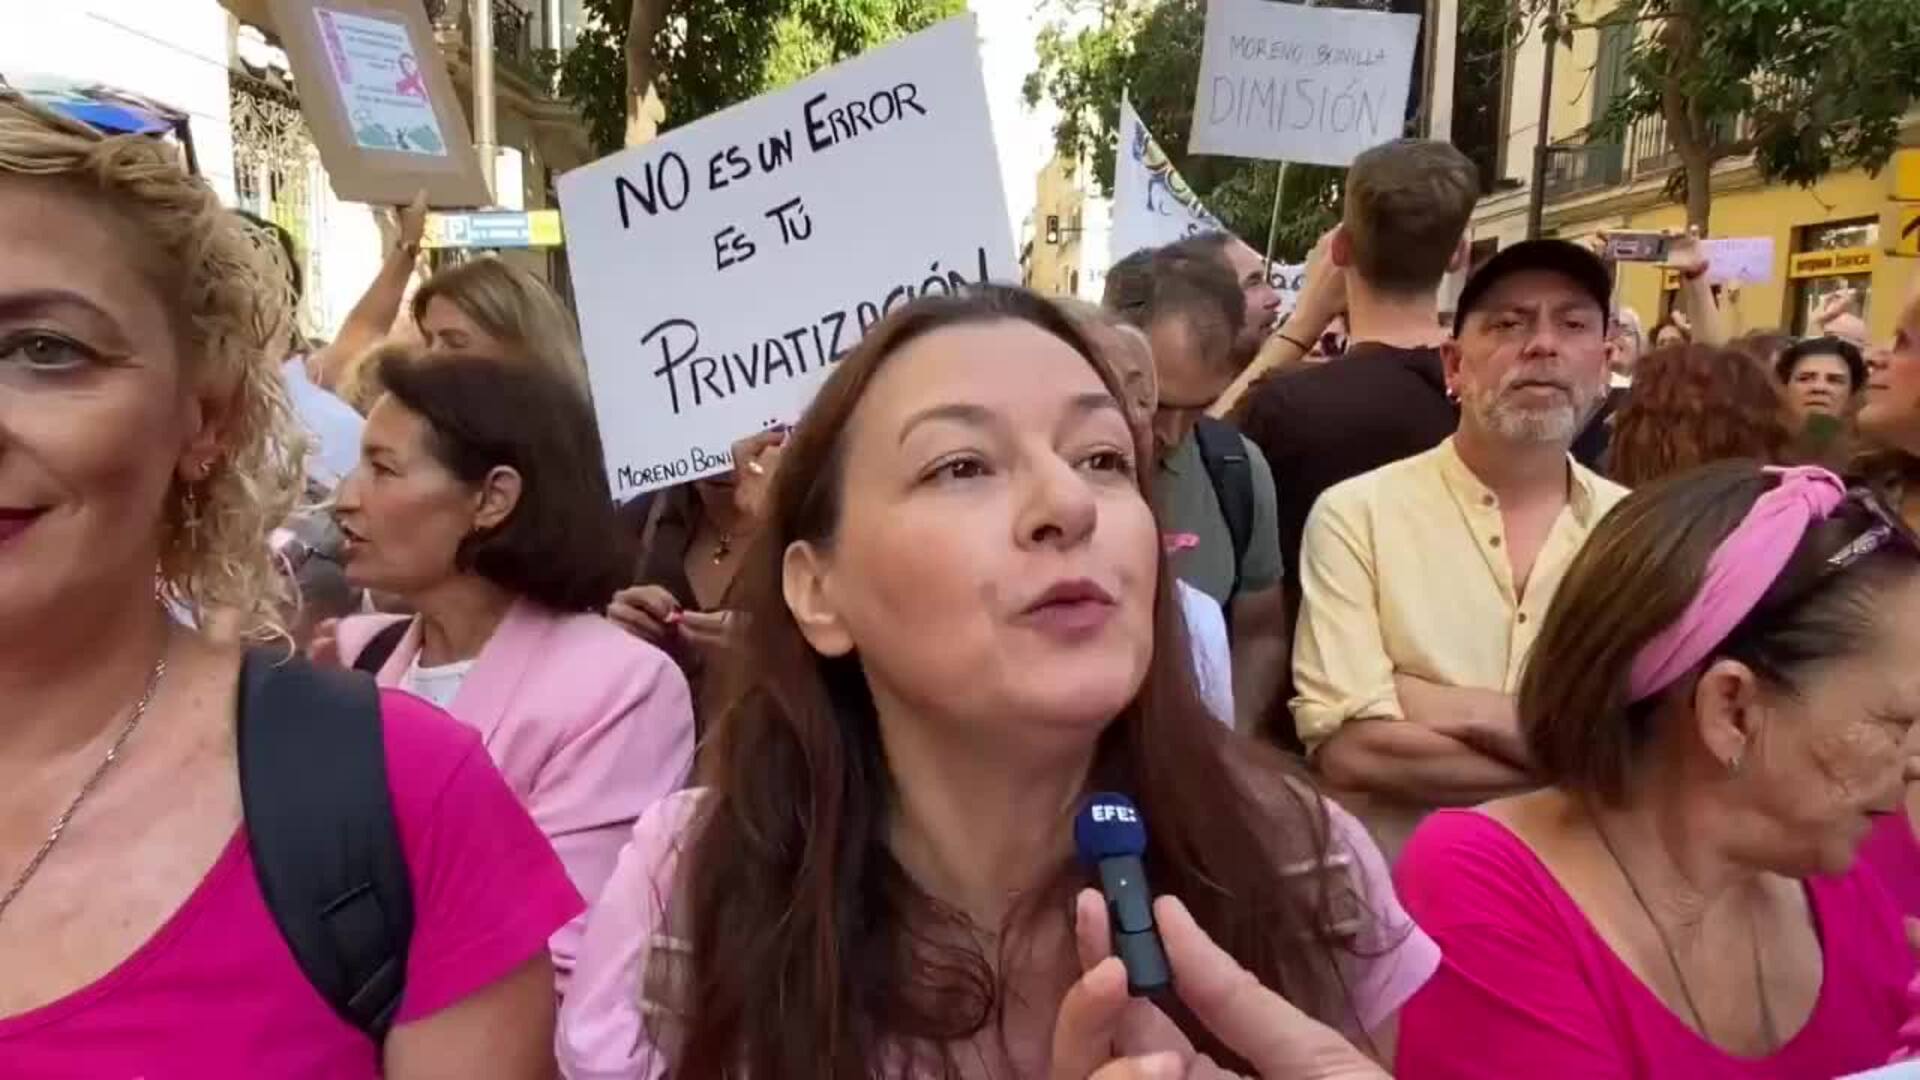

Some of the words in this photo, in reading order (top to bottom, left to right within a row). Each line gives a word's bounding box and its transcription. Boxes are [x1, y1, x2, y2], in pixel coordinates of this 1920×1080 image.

[1209, 74, 1387, 136] DIMISIÓN
[615, 151, 690, 229] NO
[708, 145, 751, 190] ES
[758, 129, 793, 173] UN
[803, 82, 926, 153] ERROR
[713, 225, 756, 271] ES
[764, 196, 812, 245] TÚ
[617, 457, 689, 491] MORENO
